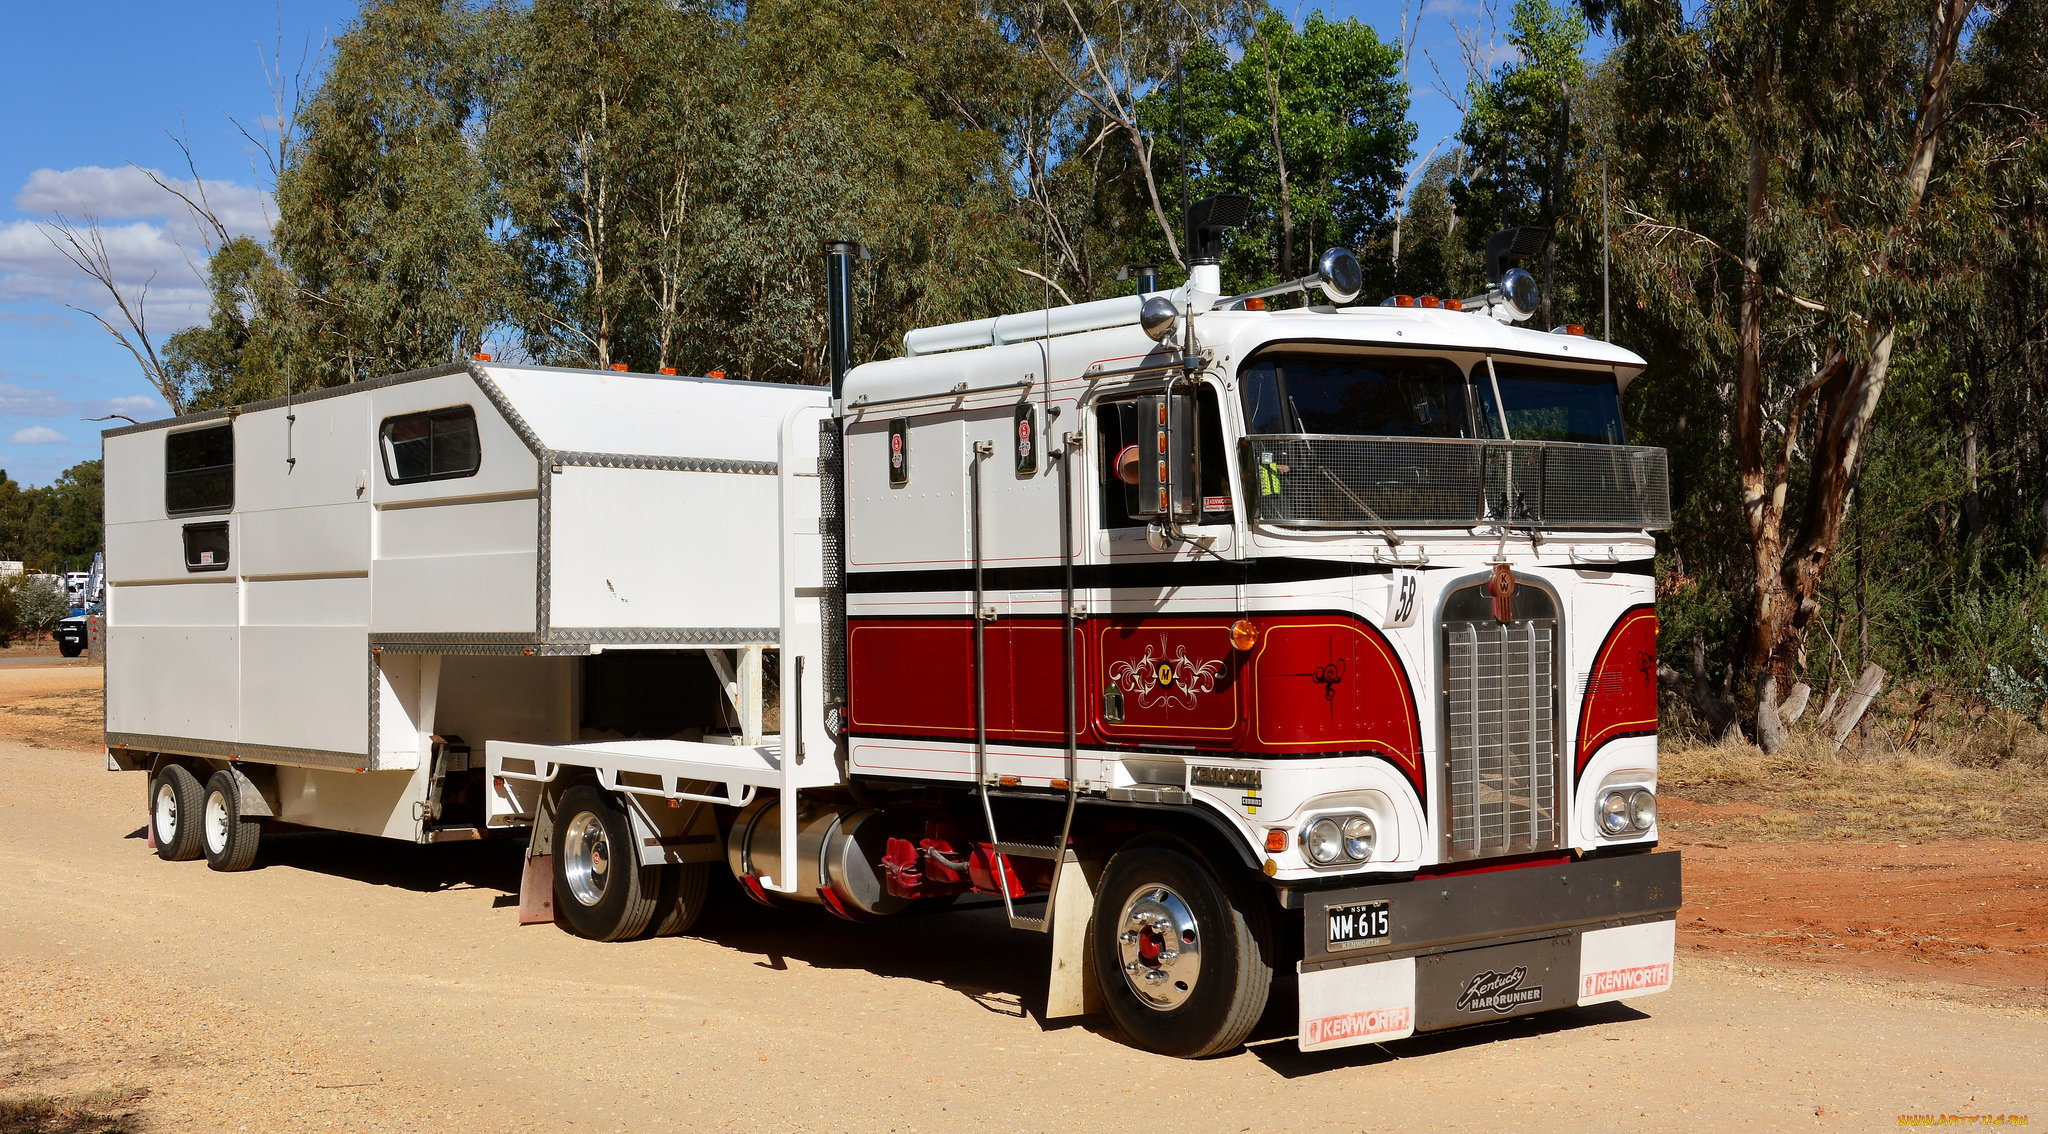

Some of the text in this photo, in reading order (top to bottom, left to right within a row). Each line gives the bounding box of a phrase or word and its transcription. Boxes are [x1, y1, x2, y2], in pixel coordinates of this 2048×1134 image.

[1395, 575, 1416, 622] 58
[1161, 669, 1170, 680] M
[1191, 766, 1262, 785] KENWORTH
[1351, 905, 1367, 913] NSW
[1342, 938, 1380, 949] KENWORTH
[1458, 968, 1525, 1008] Kentucky
[1597, 966, 1667, 991] KENWORTH
[1471, 989, 1541, 1009] HARDRUNNER
[1323, 1009, 1407, 1038] KENWORTH
